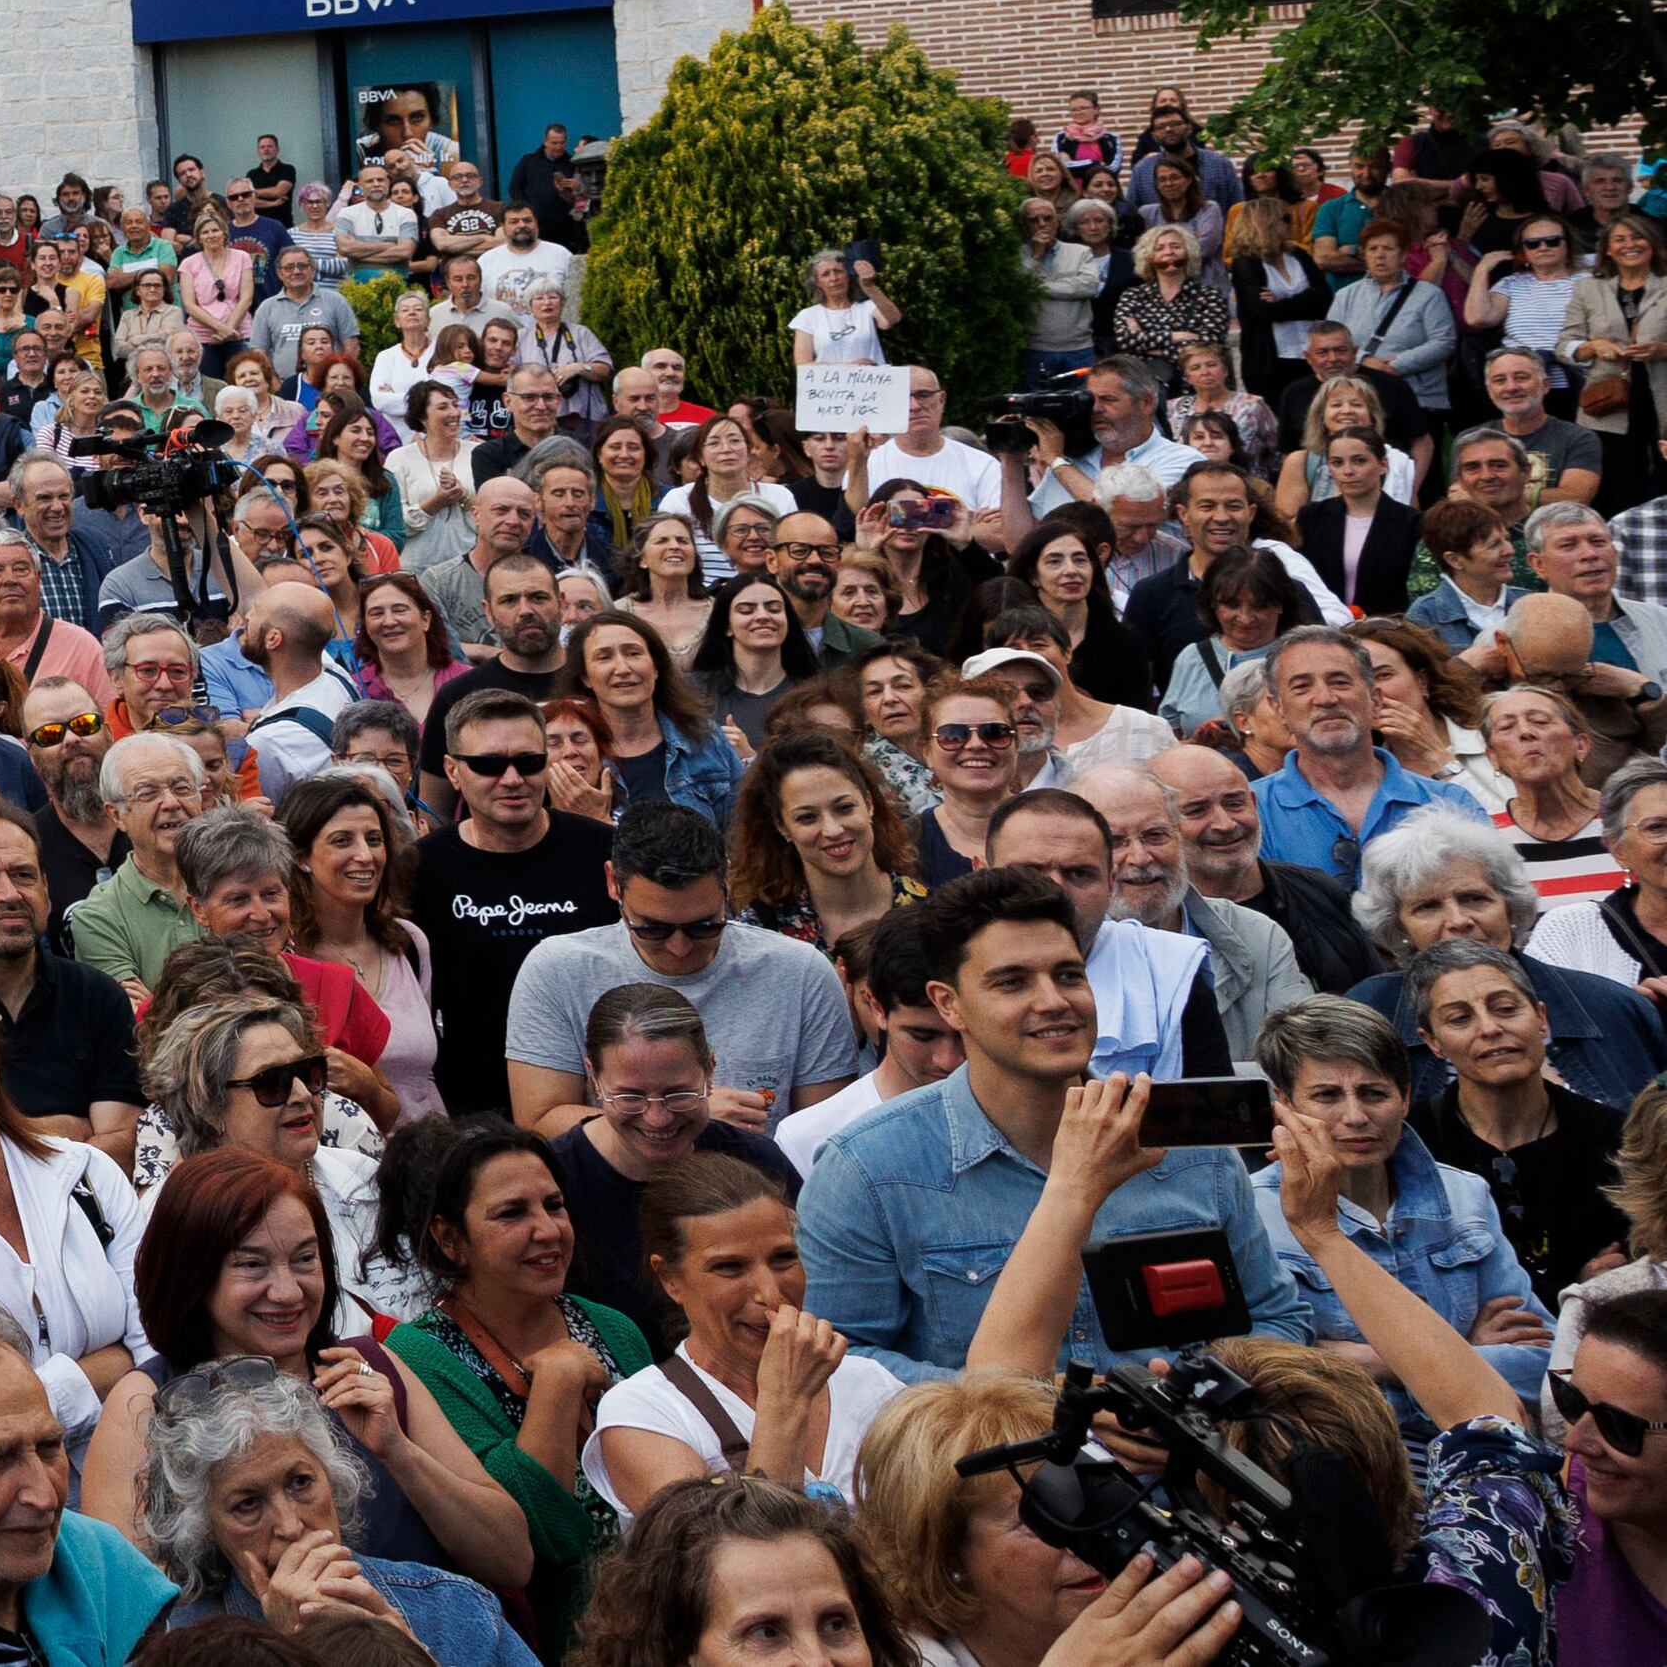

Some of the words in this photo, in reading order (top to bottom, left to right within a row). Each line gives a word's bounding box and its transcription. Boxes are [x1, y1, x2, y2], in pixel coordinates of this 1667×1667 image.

[358, 89, 398, 104] BBVA
[460, 218, 479, 232] 92
[805, 369, 815, 383] A
[823, 370, 840, 384] LA
[807, 389, 855, 400] BONITA
[862, 391, 877, 402] LA
[452, 894, 508, 926] Pepe
[508, 894, 578, 926] Jeans
[491, 928, 543, 937] LONDON
[1266, 1618, 1315, 1657] SONY
